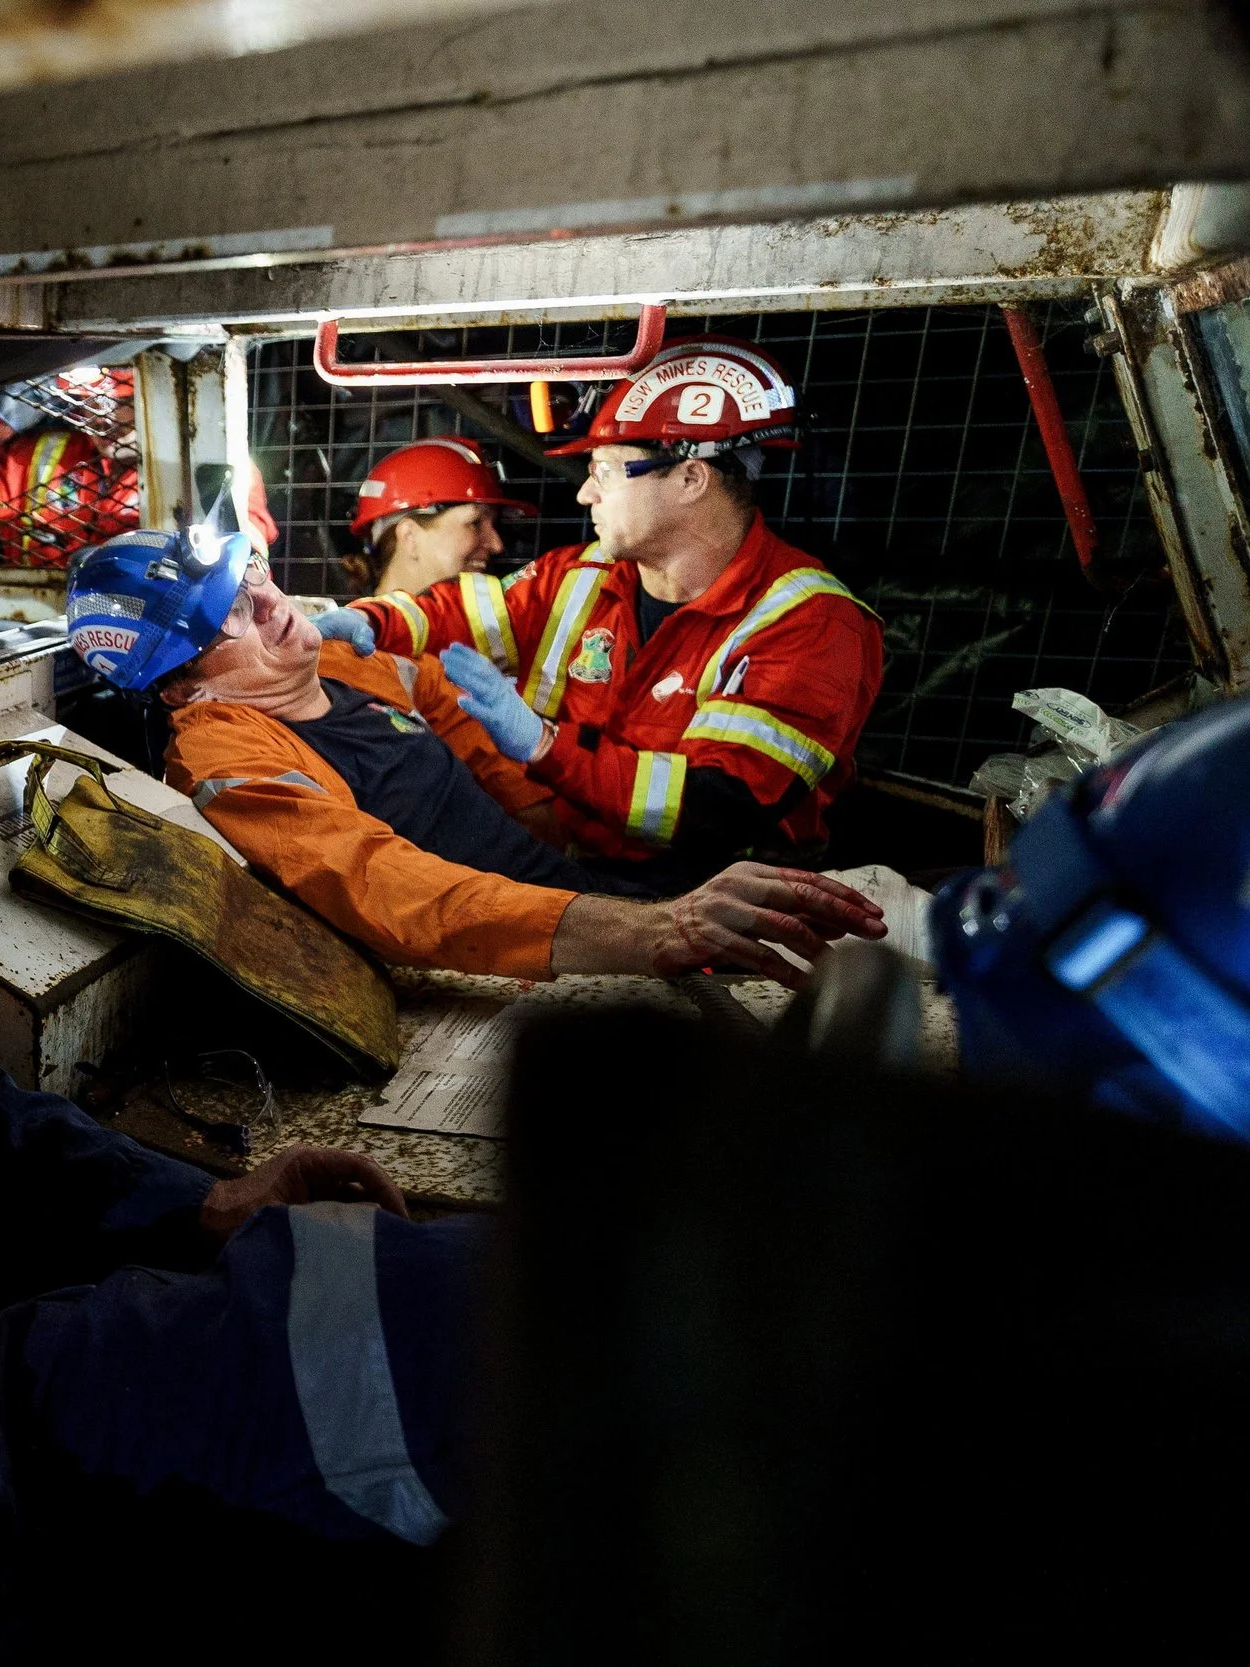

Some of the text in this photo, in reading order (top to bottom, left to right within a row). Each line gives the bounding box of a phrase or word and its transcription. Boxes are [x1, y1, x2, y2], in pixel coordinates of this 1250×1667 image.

[624, 360, 764, 416] NSW MINES RESCUE
[690, 393, 712, 417] 2
